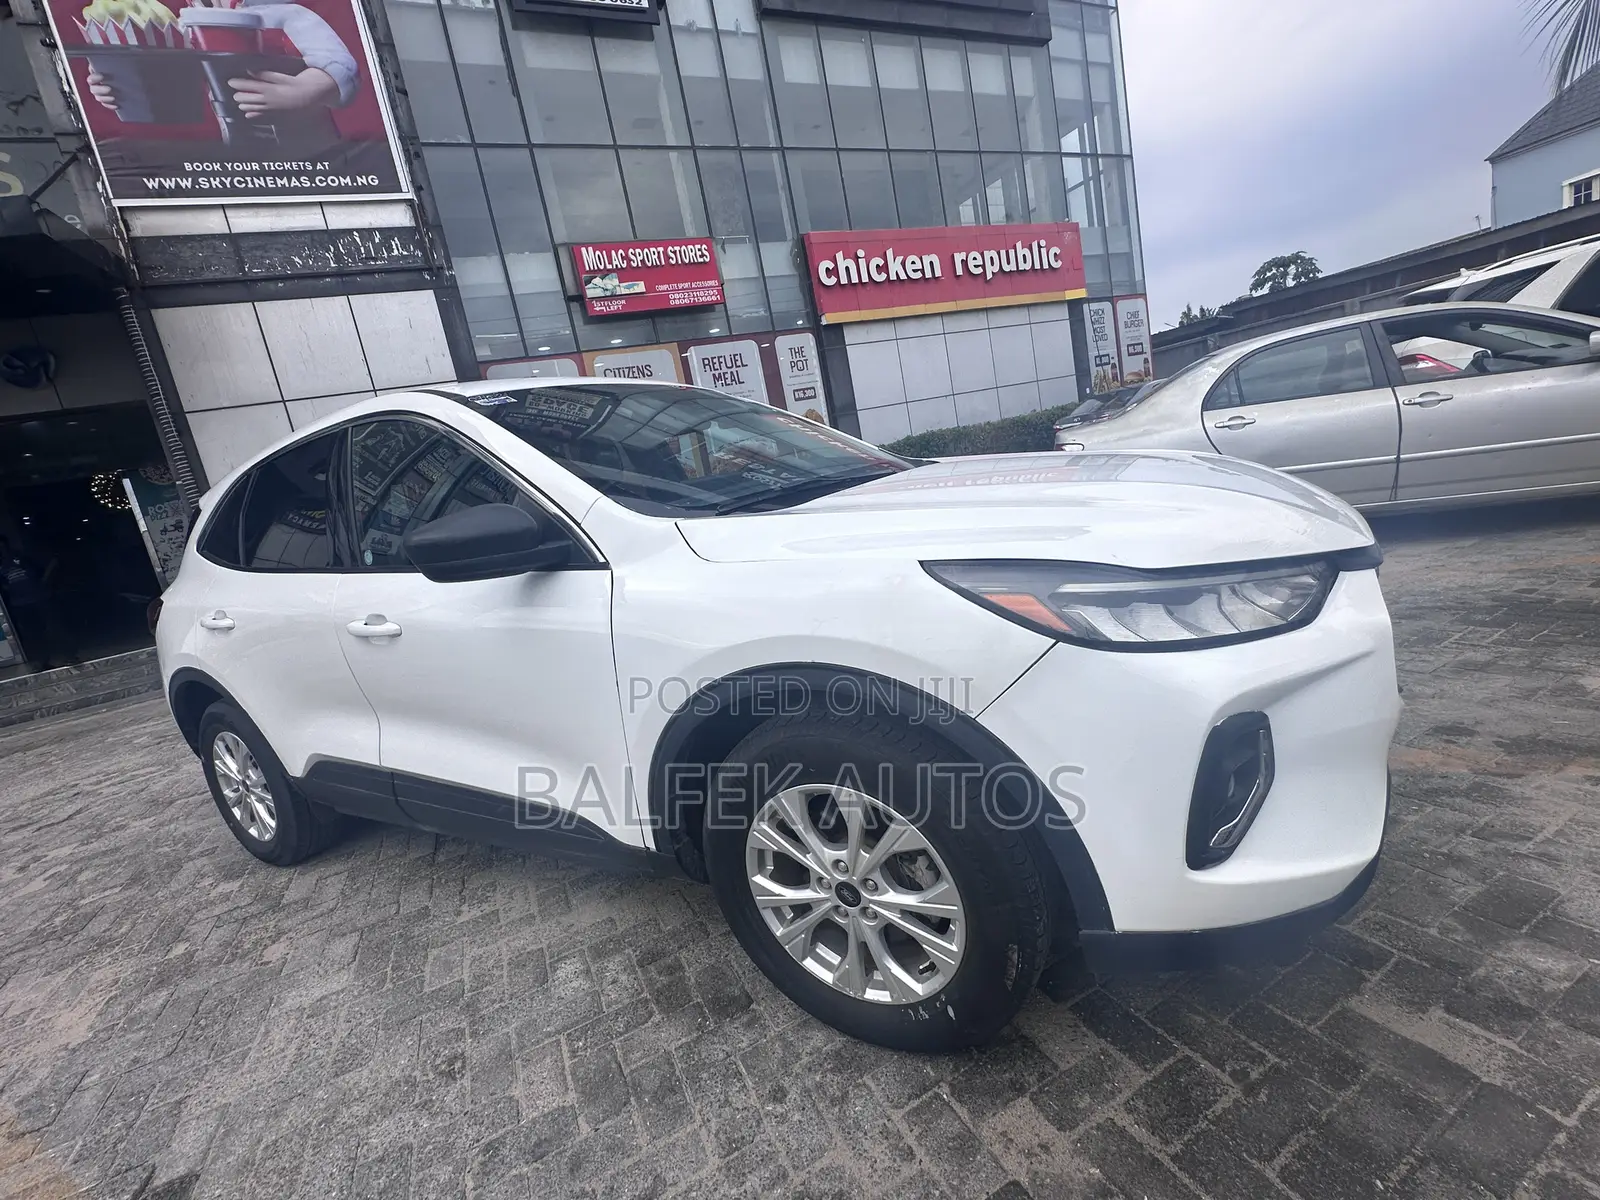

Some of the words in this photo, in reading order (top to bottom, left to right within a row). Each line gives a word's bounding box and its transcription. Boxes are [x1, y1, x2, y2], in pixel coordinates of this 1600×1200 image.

[184, 162, 222, 171] BOOK
[224, 162, 260, 171] YOUR
[262, 161, 312, 171] TICKETS
[316, 161, 330, 170] AT
[142, 174, 379, 190] WWW.SKYCINEMAS.COM.NG
[581, 246, 627, 271] MOLAC
[628, 246, 665, 268] SPORT
[667, 243, 710, 265] STORES
[817, 248, 942, 287] chicken
[953, 239, 1063, 281] republic
[655, 283, 678, 292] COMPLETE
[677, 282, 691, 290] SPORT
[690, 280, 719, 289] ACCESSORIES
[1126, 310, 1140, 320] CHIEF
[1124, 319, 1144, 329] BURGER
[788, 346, 806, 360] THE
[701, 353, 748, 372] REFUEL
[790, 359, 809, 373] POT
[712, 370, 745, 388] MEAL
